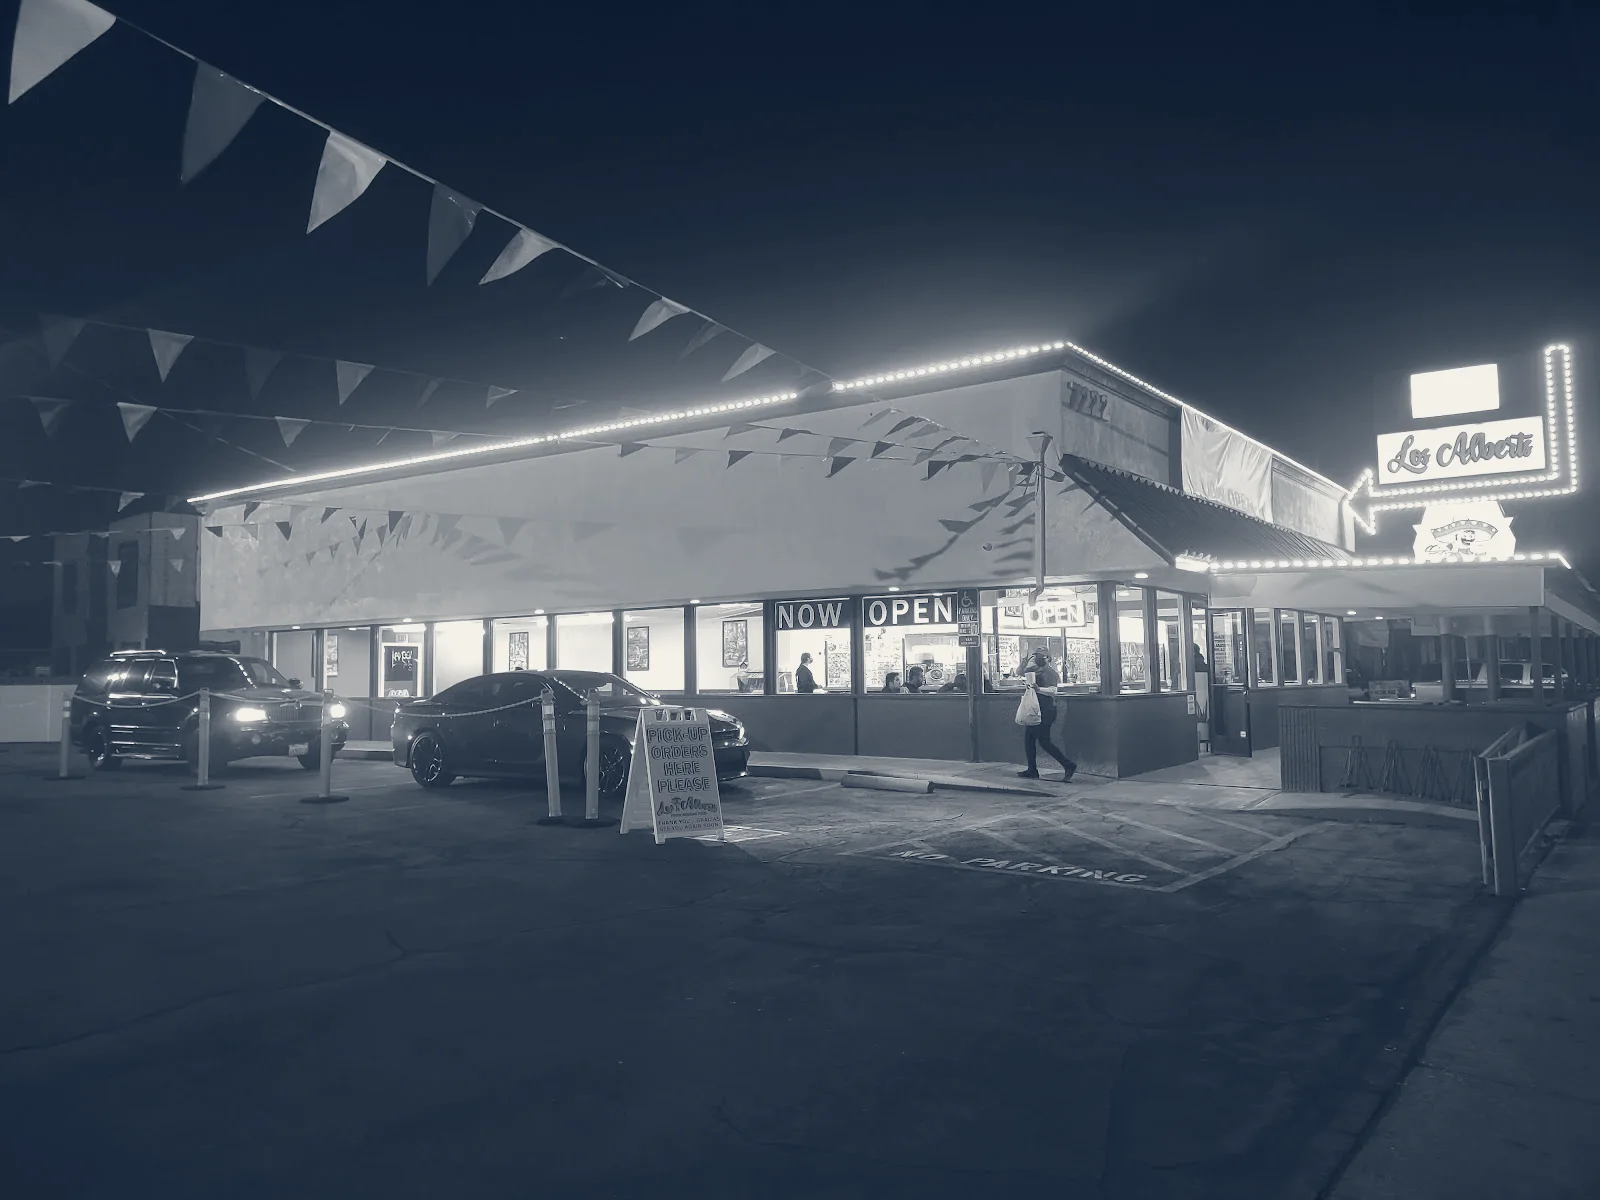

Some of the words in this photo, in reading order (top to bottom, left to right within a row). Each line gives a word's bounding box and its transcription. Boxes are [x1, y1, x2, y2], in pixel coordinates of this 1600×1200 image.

[1387, 434, 1431, 474] Los
[1436, 431, 1533, 467] Alberts
[778, 602, 842, 628] NOW
[868, 597, 952, 626] OPEN
[1029, 604, 1080, 625] OPEN
[647, 727, 708, 743] PICK-UP
[651, 744, 708, 759] ORDERS
[664, 761, 701, 776] HERE
[657, 778, 711, 793] PLEASE
[889, 850, 949, 860] NO
[960, 857, 1148, 882] PARKING
